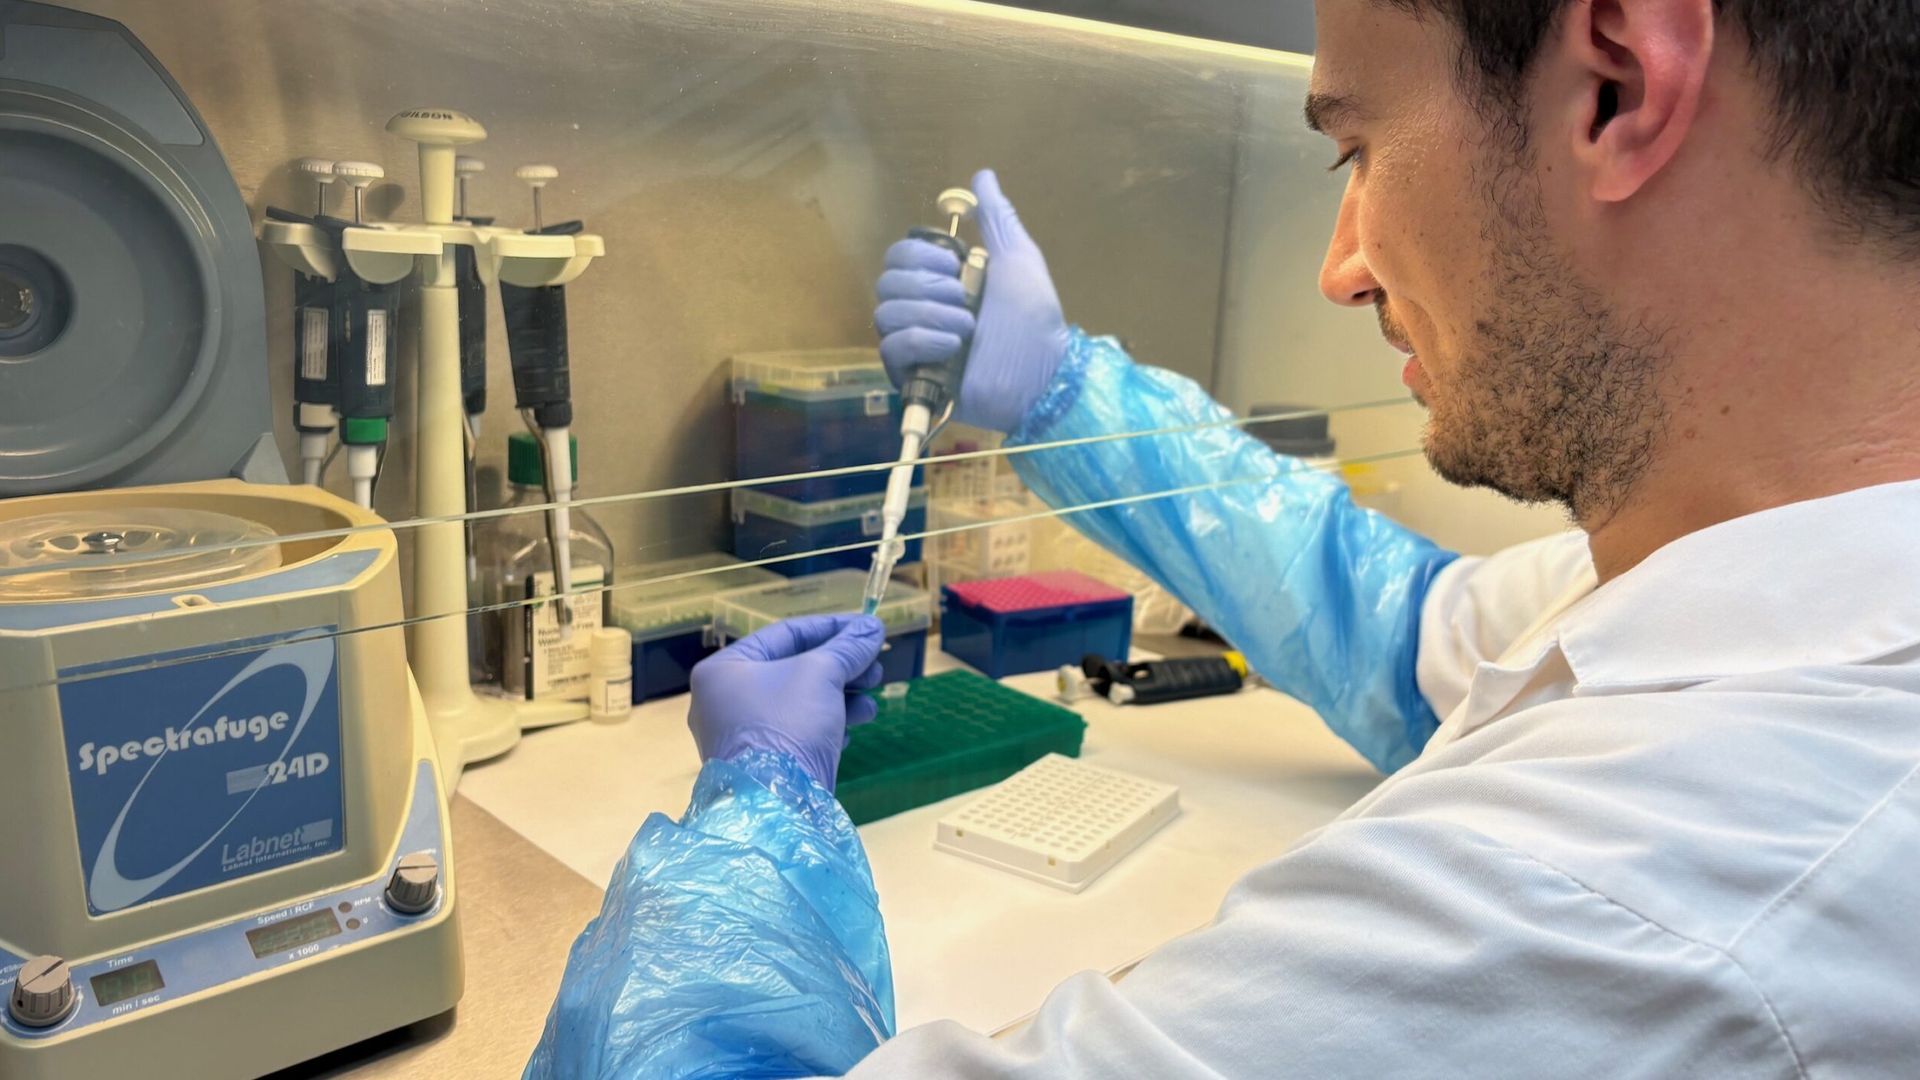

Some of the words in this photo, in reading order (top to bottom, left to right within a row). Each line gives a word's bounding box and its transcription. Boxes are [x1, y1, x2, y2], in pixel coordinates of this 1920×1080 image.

[79, 711, 289, 775] Spectrafuge
[267, 752, 329, 785] 24D
[222, 826, 301, 864] Labnet
[223, 859, 252, 872] Labnet
[257, 909, 288, 925] Speed
[294, 901, 315, 914] RCF
[297, 944, 319, 957] 1000
[107, 956, 134, 968] Time
[112, 1003, 133, 1015] min
[142, 994, 160, 1005] sec
